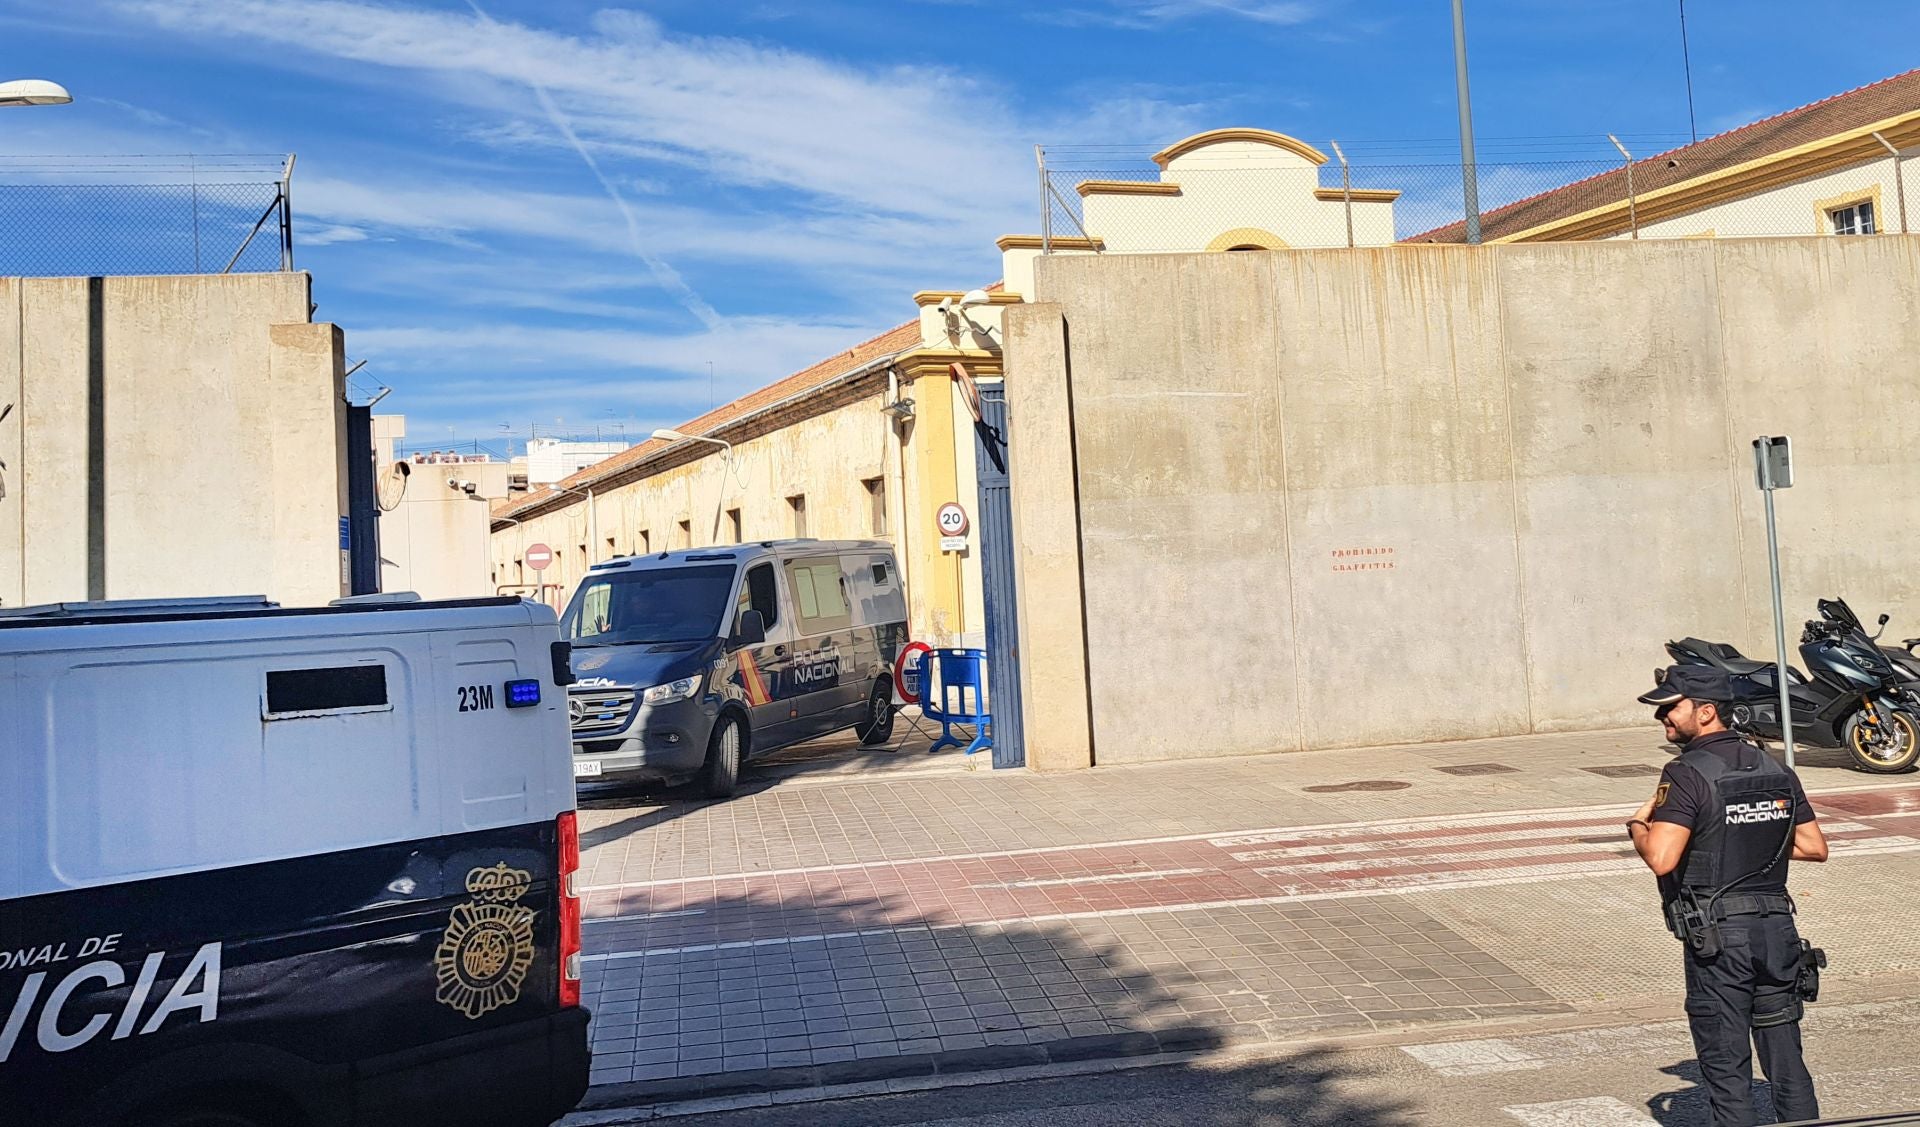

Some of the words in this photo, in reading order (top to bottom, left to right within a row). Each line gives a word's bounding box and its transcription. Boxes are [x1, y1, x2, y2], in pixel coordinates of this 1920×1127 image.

[943, 513, 961, 525] 20
[1332, 547, 1394, 557] PROHIBIDO
[1332, 562, 1394, 571] GRAFFITIS
[793, 645, 841, 667] POLICIA
[794, 658, 856, 685] NACIONAL
[575, 677, 609, 687] ICIA
[457, 684, 494, 712] 23M
[1725, 800, 1780, 815] POLICIA
[1725, 809, 1791, 825] NACIONAL
[77, 932, 123, 958] DE
